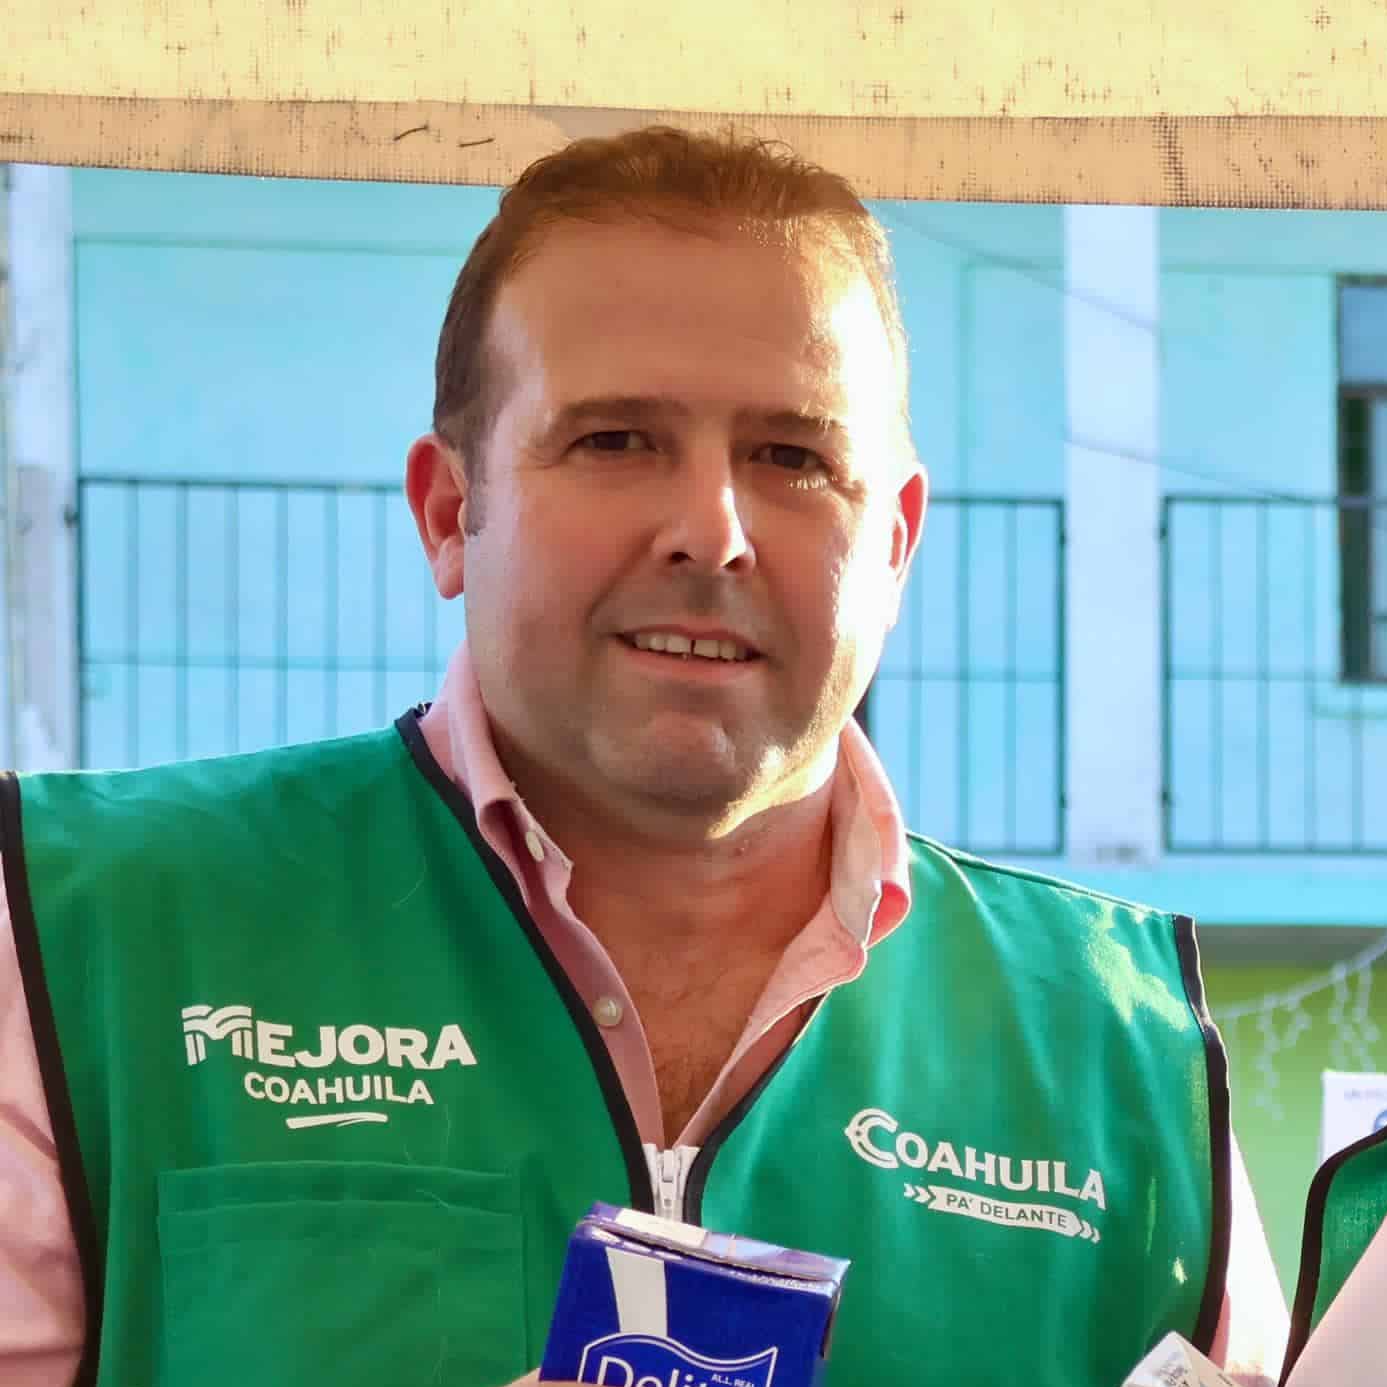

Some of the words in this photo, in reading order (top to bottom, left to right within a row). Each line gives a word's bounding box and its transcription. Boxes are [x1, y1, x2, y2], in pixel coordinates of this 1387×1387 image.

[181, 1005, 477, 1070] MEJORA
[244, 1072, 434, 1105] COAHUILA
[844, 1107, 1106, 1210] COAHUILA
[979, 1201, 1067, 1228] DELANTE
